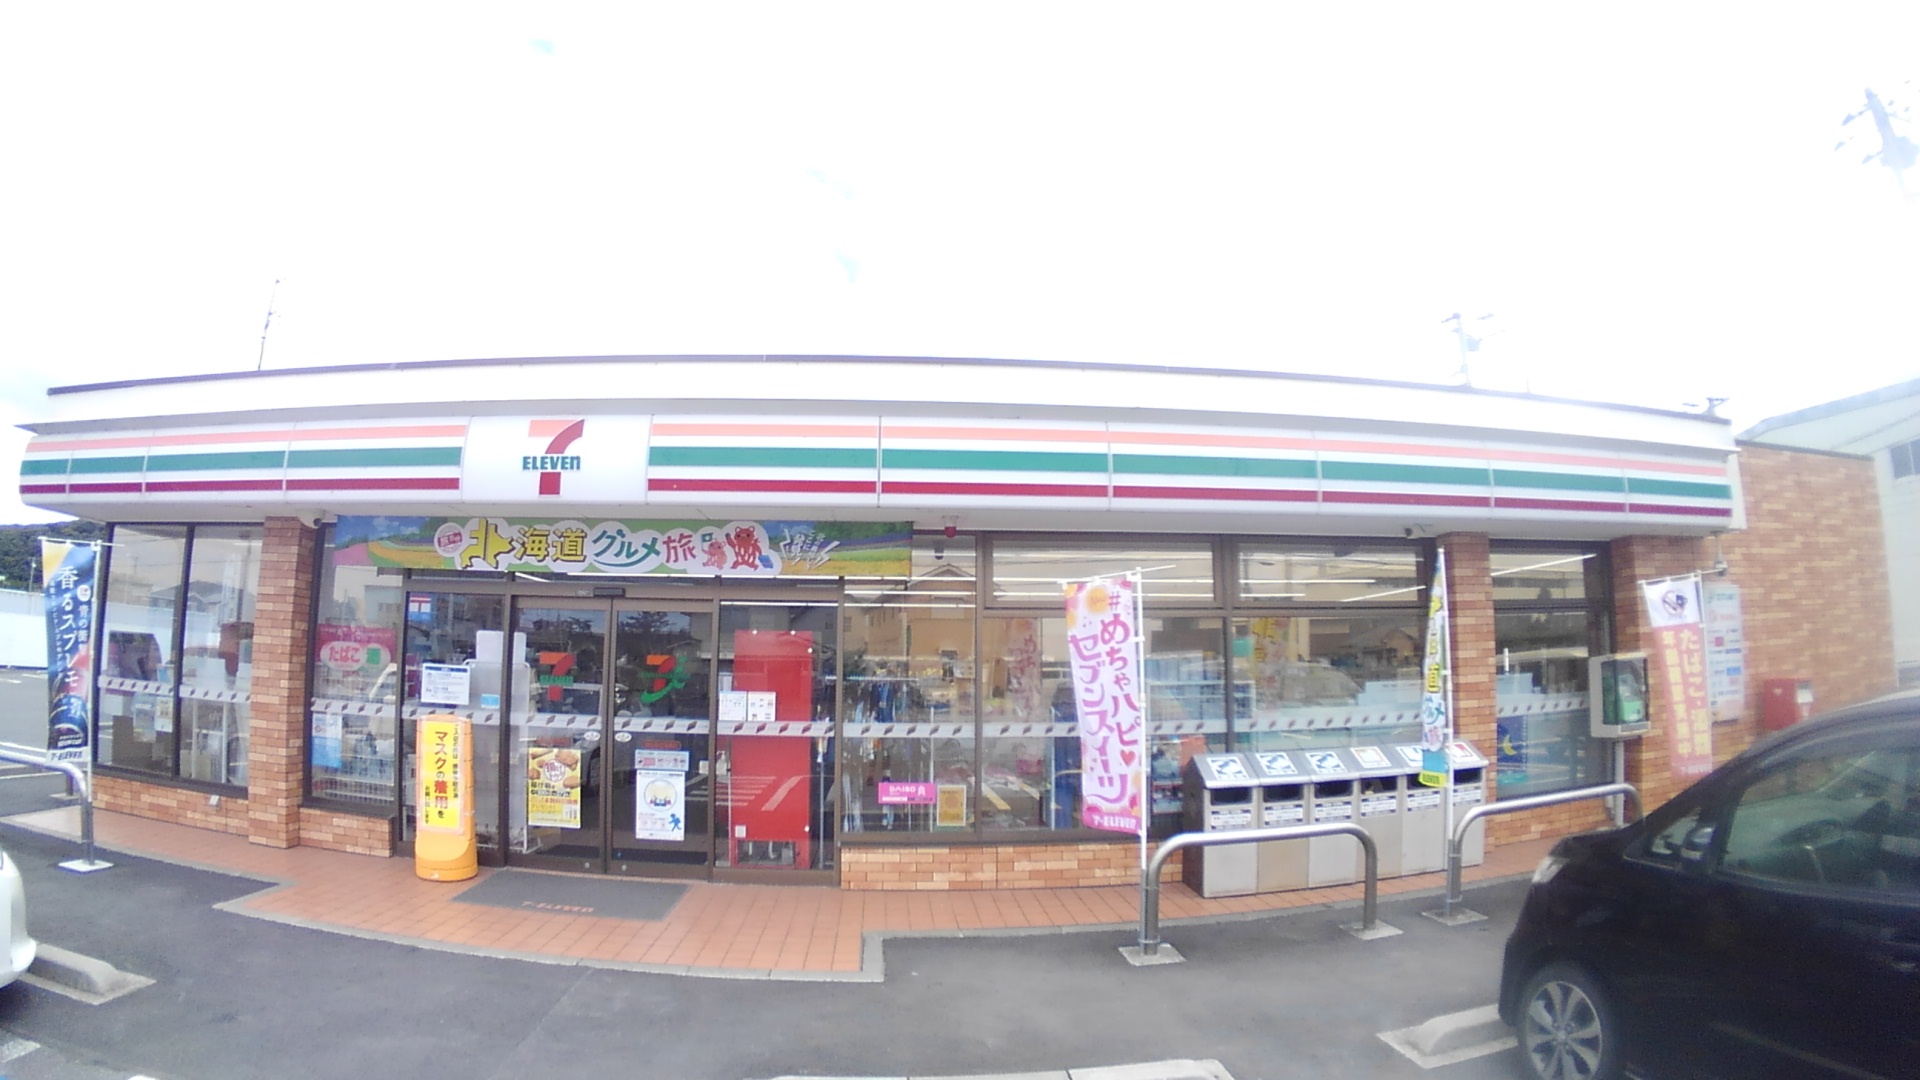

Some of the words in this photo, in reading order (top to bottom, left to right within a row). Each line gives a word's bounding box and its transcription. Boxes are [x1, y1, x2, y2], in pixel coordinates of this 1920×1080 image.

[528, 419, 585, 495] 7
[57, 566, 80, 688] 香るスプレモ
[1069, 633, 1129, 806] セブンスイーツ
[434, 730, 449, 819] マスクの着用を
